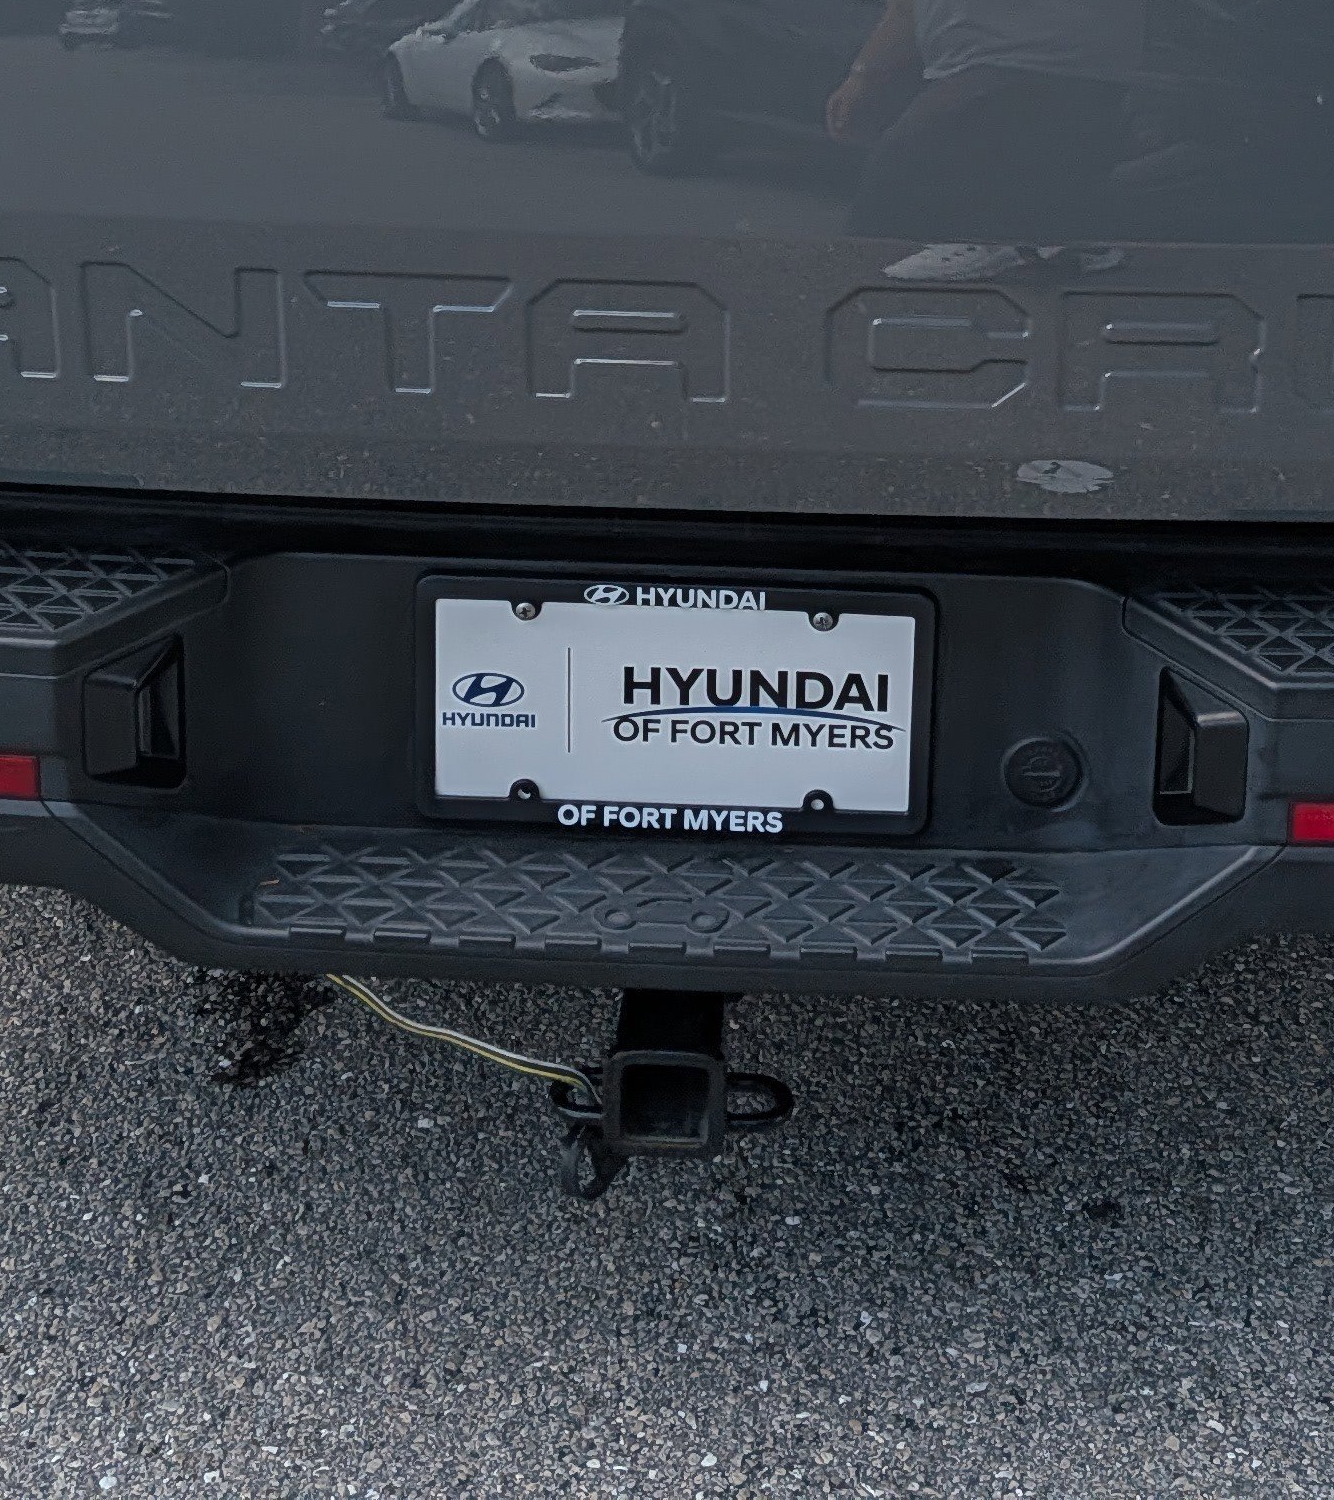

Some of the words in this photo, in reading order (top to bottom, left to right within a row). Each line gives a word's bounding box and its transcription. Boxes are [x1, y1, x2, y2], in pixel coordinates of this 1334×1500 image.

[636, 586, 766, 611] HYUNDAI
[623, 666, 889, 713] HYUNDAI
[442, 712, 536, 728] HYUNDAI
[613, 717, 661, 743] OF
[670, 719, 763, 746] FORT
[771, 722, 894, 750] MYERS
[557, 804, 597, 827] OF
[603, 806, 678, 830] FORT
[683, 809, 784, 834] MYERS
